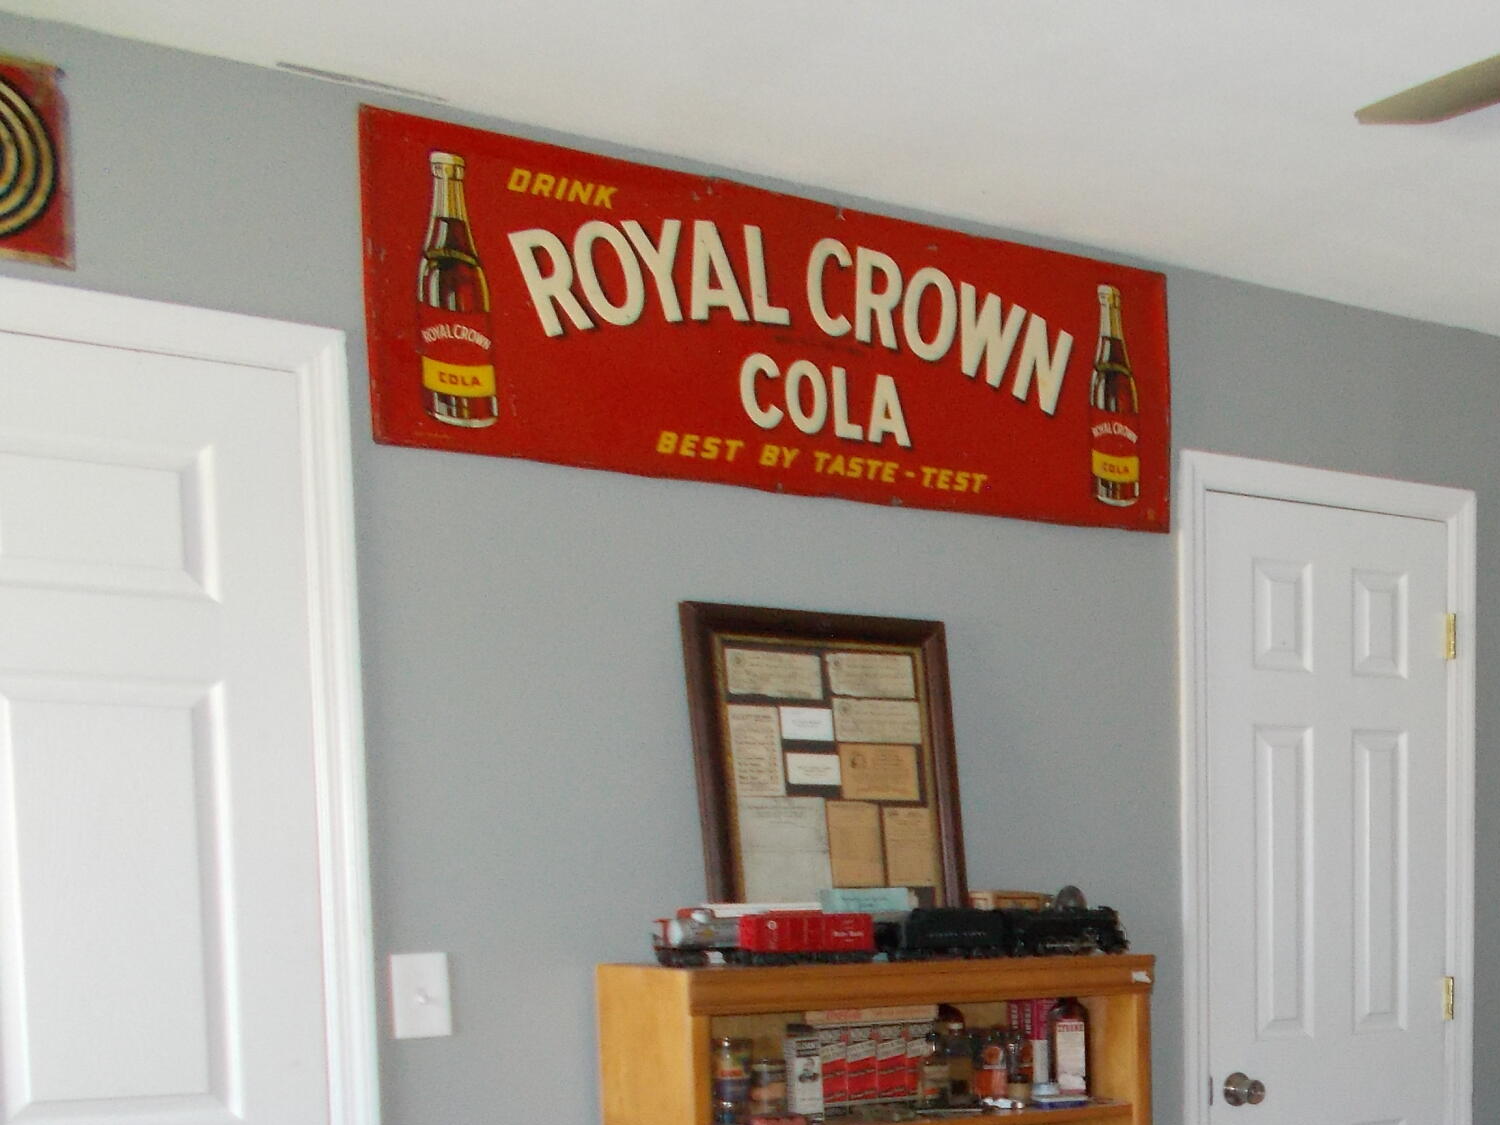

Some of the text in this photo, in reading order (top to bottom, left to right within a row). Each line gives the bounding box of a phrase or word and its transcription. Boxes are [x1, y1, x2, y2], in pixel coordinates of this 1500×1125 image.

[506, 167, 619, 209] DRINK
[421, 323, 492, 350] ROYAL CROWN
[507, 219, 1074, 417] ROYAL CROWN
[437, 371, 482, 386] COLA
[739, 352, 912, 448] COLA
[655, 431, 744, 463] BEST
[759, 445, 799, 468] BY
